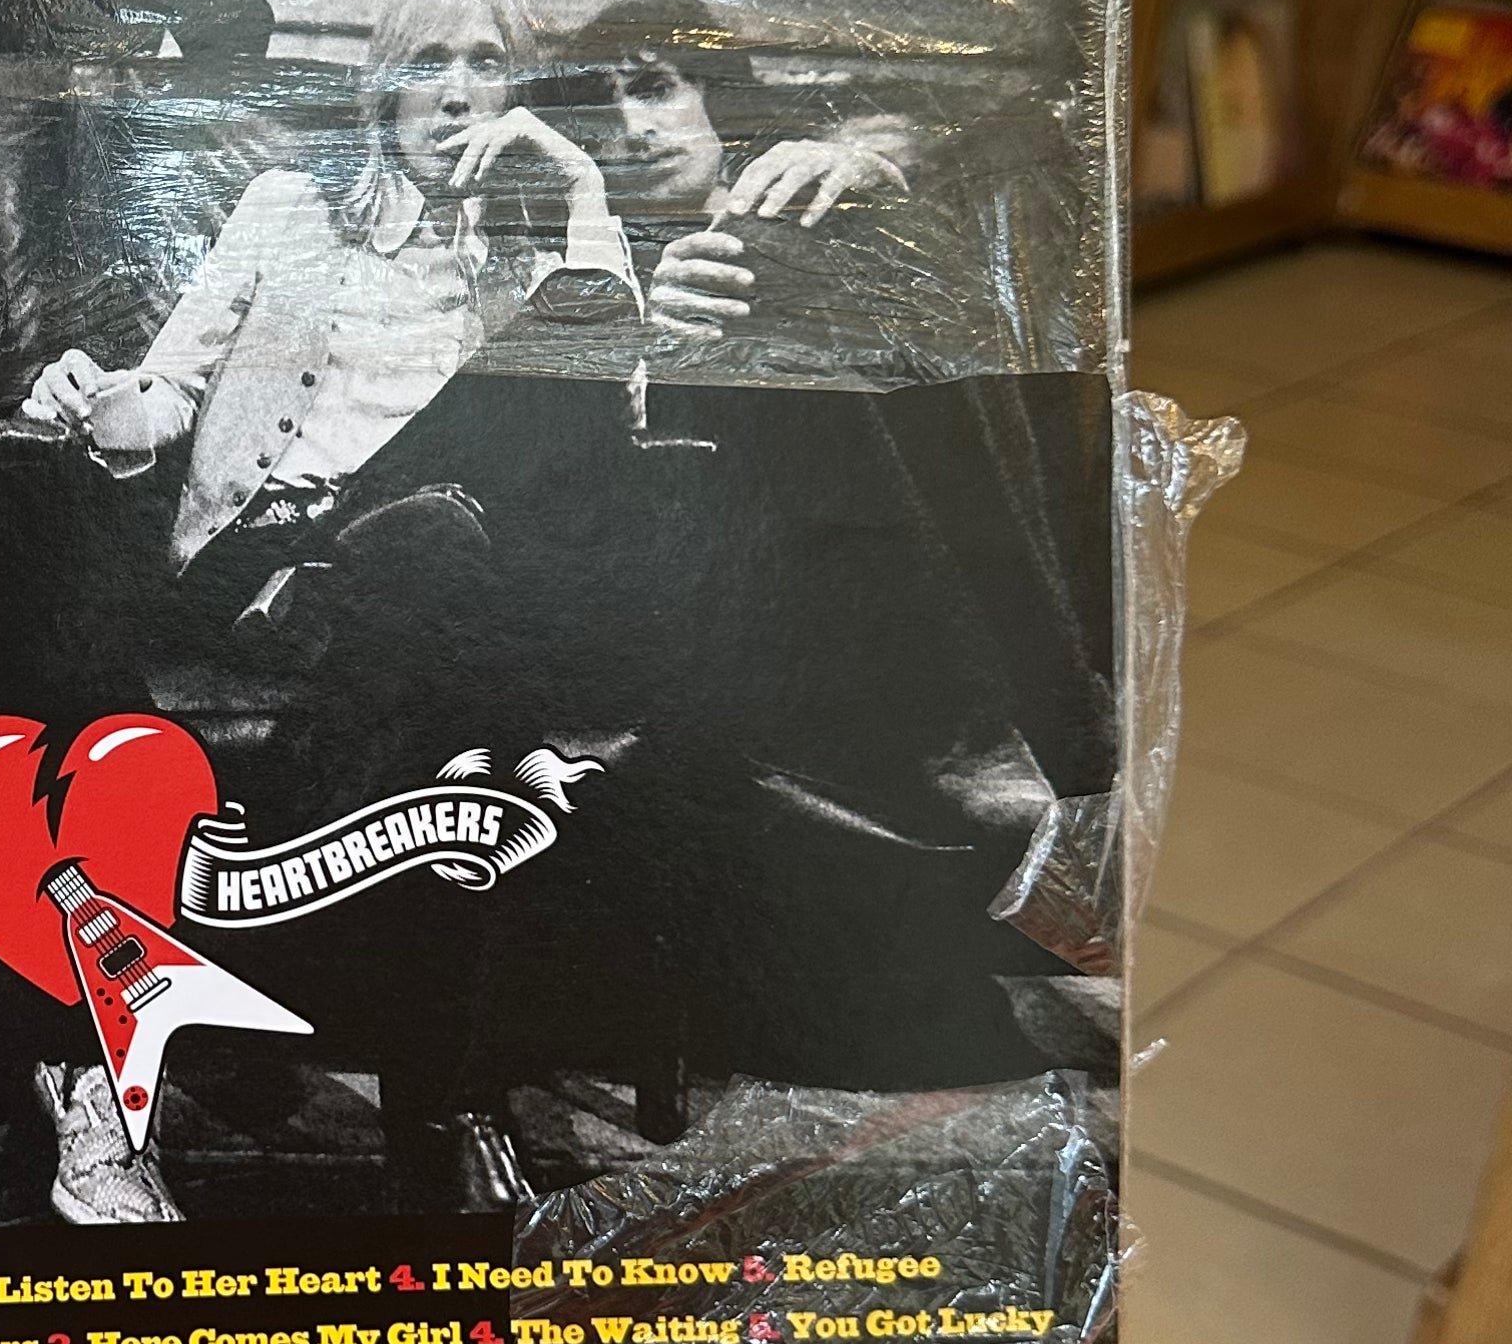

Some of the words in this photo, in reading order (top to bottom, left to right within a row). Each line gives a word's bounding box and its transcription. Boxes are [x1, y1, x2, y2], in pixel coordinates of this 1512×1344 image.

[215, 802, 505, 915] HEARTBREAKERS
[123, 1271, 175, 1301] To
[182, 1269, 258, 1298] Her
[265, 1265, 382, 1296] Heart
[389, 1264, 426, 1292] 4.
[432, 1262, 451, 1290] I
[458, 1260, 555, 1291] Need
[562, 1258, 614, 1287] To
[621, 1257, 736, 1286] Know
[782, 1252, 941, 1283] Refugee
[786, 1309, 860, 1341] You
[866, 1307, 933, 1337] Got
[938, 1304, 1055, 1338] Lucky
